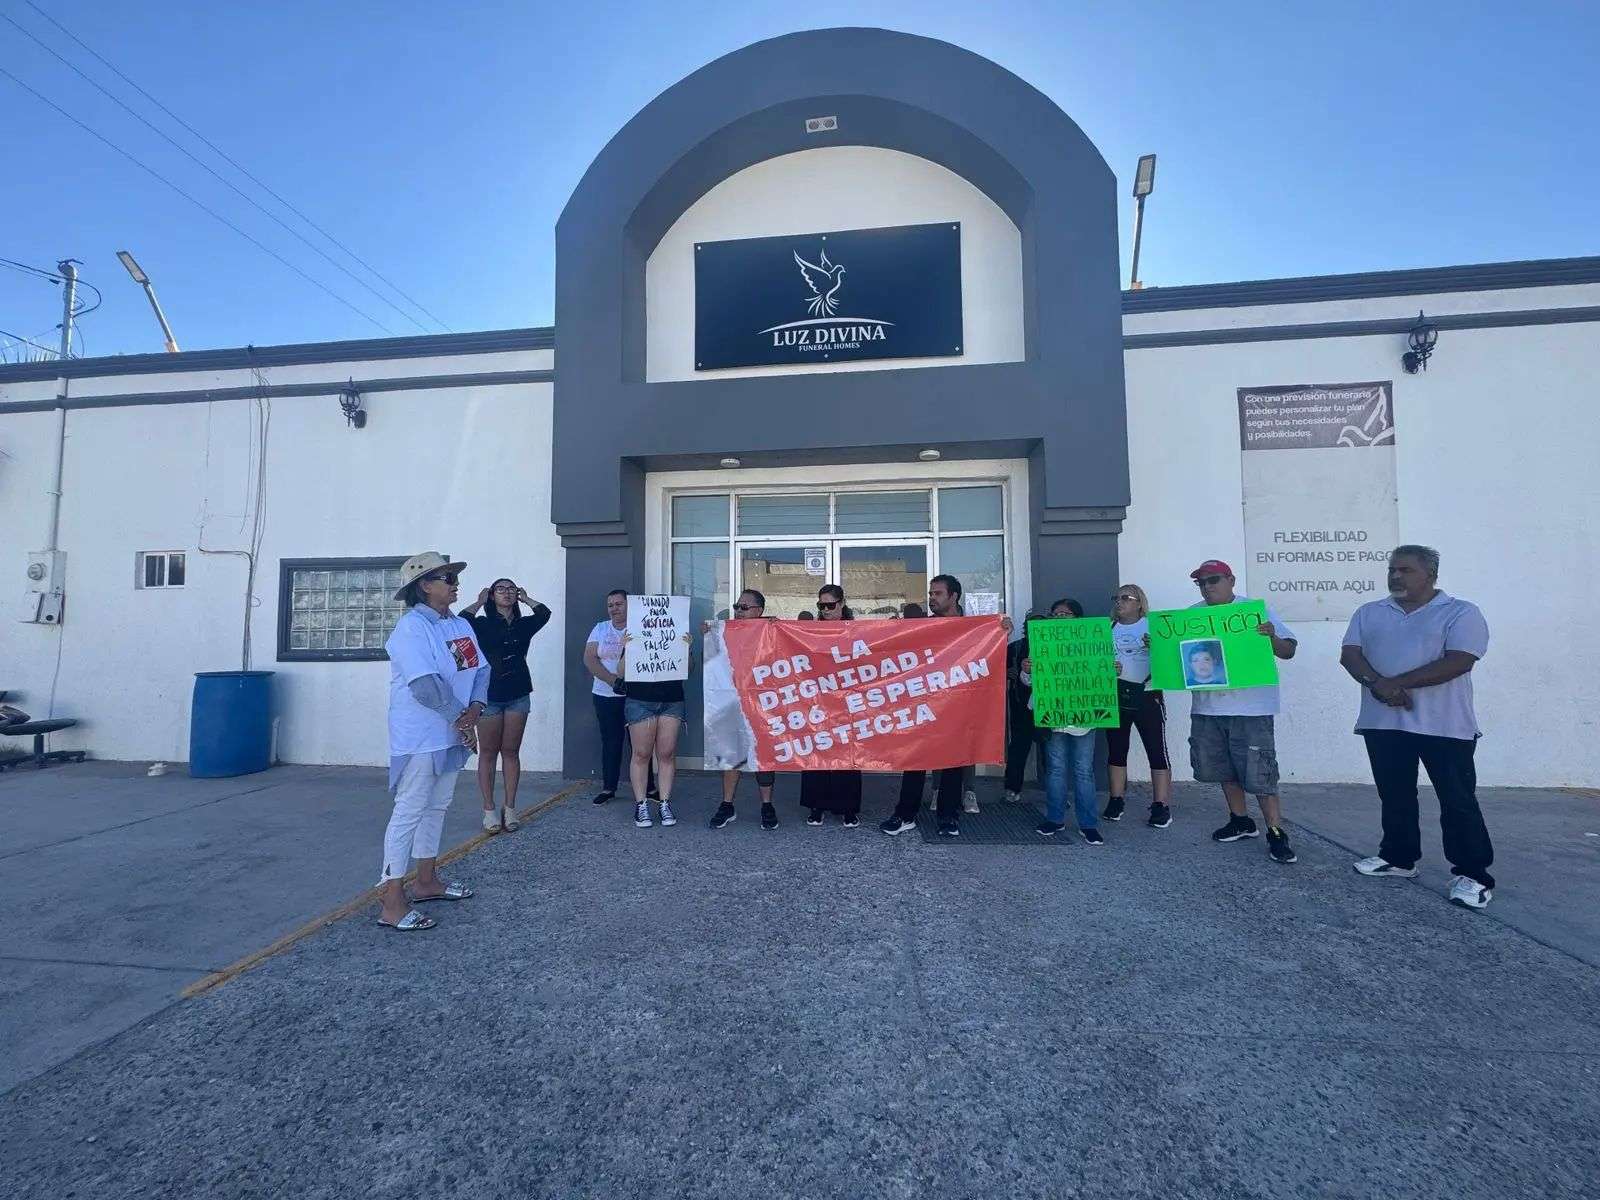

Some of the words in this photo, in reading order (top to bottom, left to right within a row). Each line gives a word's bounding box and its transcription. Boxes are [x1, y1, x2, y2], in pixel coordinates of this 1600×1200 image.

[773, 329, 810, 346] LUZ
[815, 325, 886, 344] DIVINA
[799, 343, 832, 352] FUNERAL
[833, 341, 861, 350] HOMES
[1244, 393, 1263, 403] Con
[1264, 395, 1281, 403] una
[1282, 392, 1327, 405] previsión
[1328, 389, 1372, 400] funeraria
[1245, 405, 1278, 417] puedes
[1279, 404, 1332, 416] personalizar
[1333, 403, 1345, 412] tu
[1346, 402, 1366, 413] plan
[1274, 417, 1291, 427] tus
[1291, 415, 1348, 426] necesidades
[1247, 432, 1254, 441] y
[1273, 530, 1368, 544] FLEXIBILIDAD
[1256, 551, 1275, 563] EN
[1277, 550, 1335, 563] FORMAS
[1337, 550, 1356, 562] DE
[1268, 580, 1339, 592] CONTRATA
[1343, 580, 1376, 594] AQUI
[641, 614, 675, 629] JUSTICIA
[660, 629, 676, 642] NO
[1092, 623, 1104, 638] A
[644, 640, 670, 651] FALTE
[649, 652, 660, 661] LA
[752, 654, 813, 686] POR
[830, 639, 872, 664] LA
[1035, 661, 1044, 673] A
[1098, 657, 1109, 673] A
[758, 648, 935, 712] DIGNIDAD:
[767, 704, 827, 737] 386
[845, 658, 990, 714] ESPERAN
[1053, 709, 1093, 725] DIGNO
[774, 703, 937, 763] JUSTICIA
